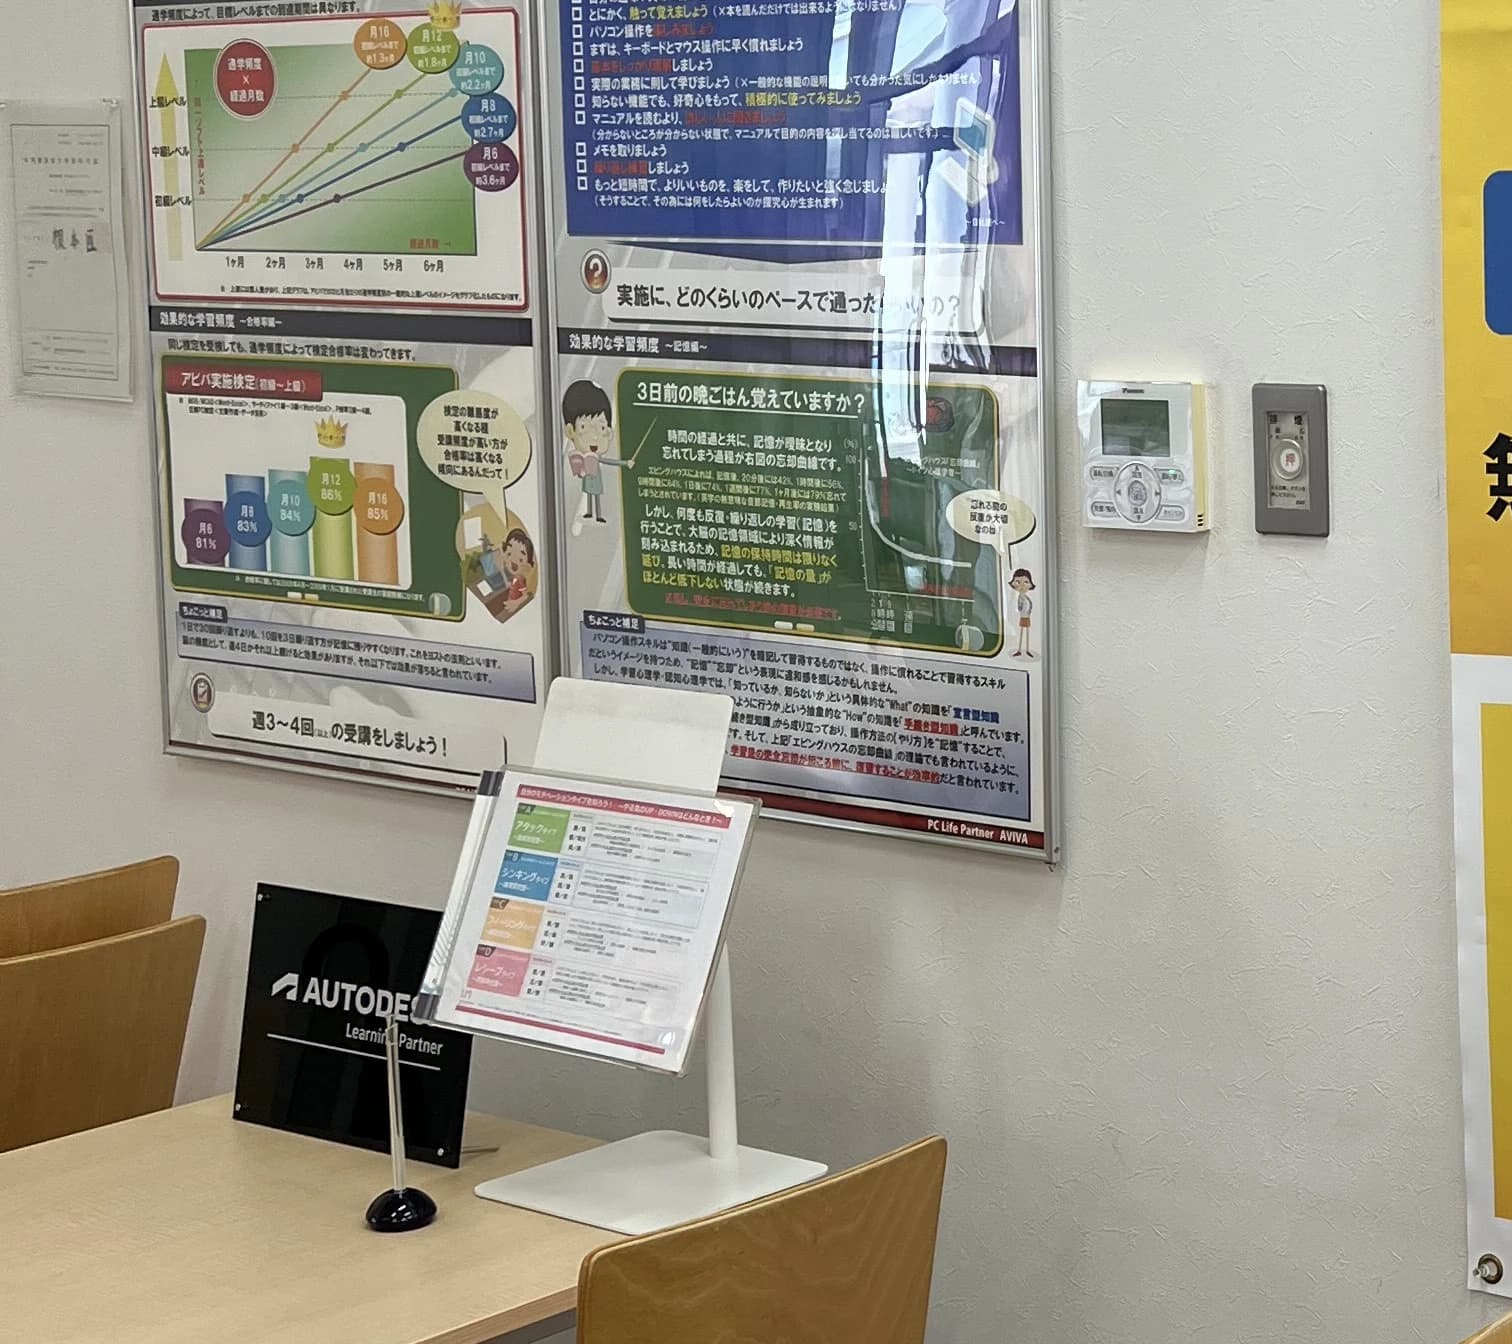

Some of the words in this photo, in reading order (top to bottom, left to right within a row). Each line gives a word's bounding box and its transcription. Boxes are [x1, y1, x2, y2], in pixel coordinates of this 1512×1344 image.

[593, 144, 667, 156] メモを取りましょう
[160, 312, 235, 329] 効果的な学習頻度
[569, 332, 659, 354] 効果的な学習頻度
[637, 382, 865, 413] 3日前の晩ごはん覚えていますか？
[927, 819, 940, 831] PC
[941, 820, 958, 835] Life
[960, 824, 994, 840] Partner
[999, 829, 1028, 845] AVIVA
[346, 1023, 388, 1044] Learnin
[399, 1035, 443, 1056] Partner
